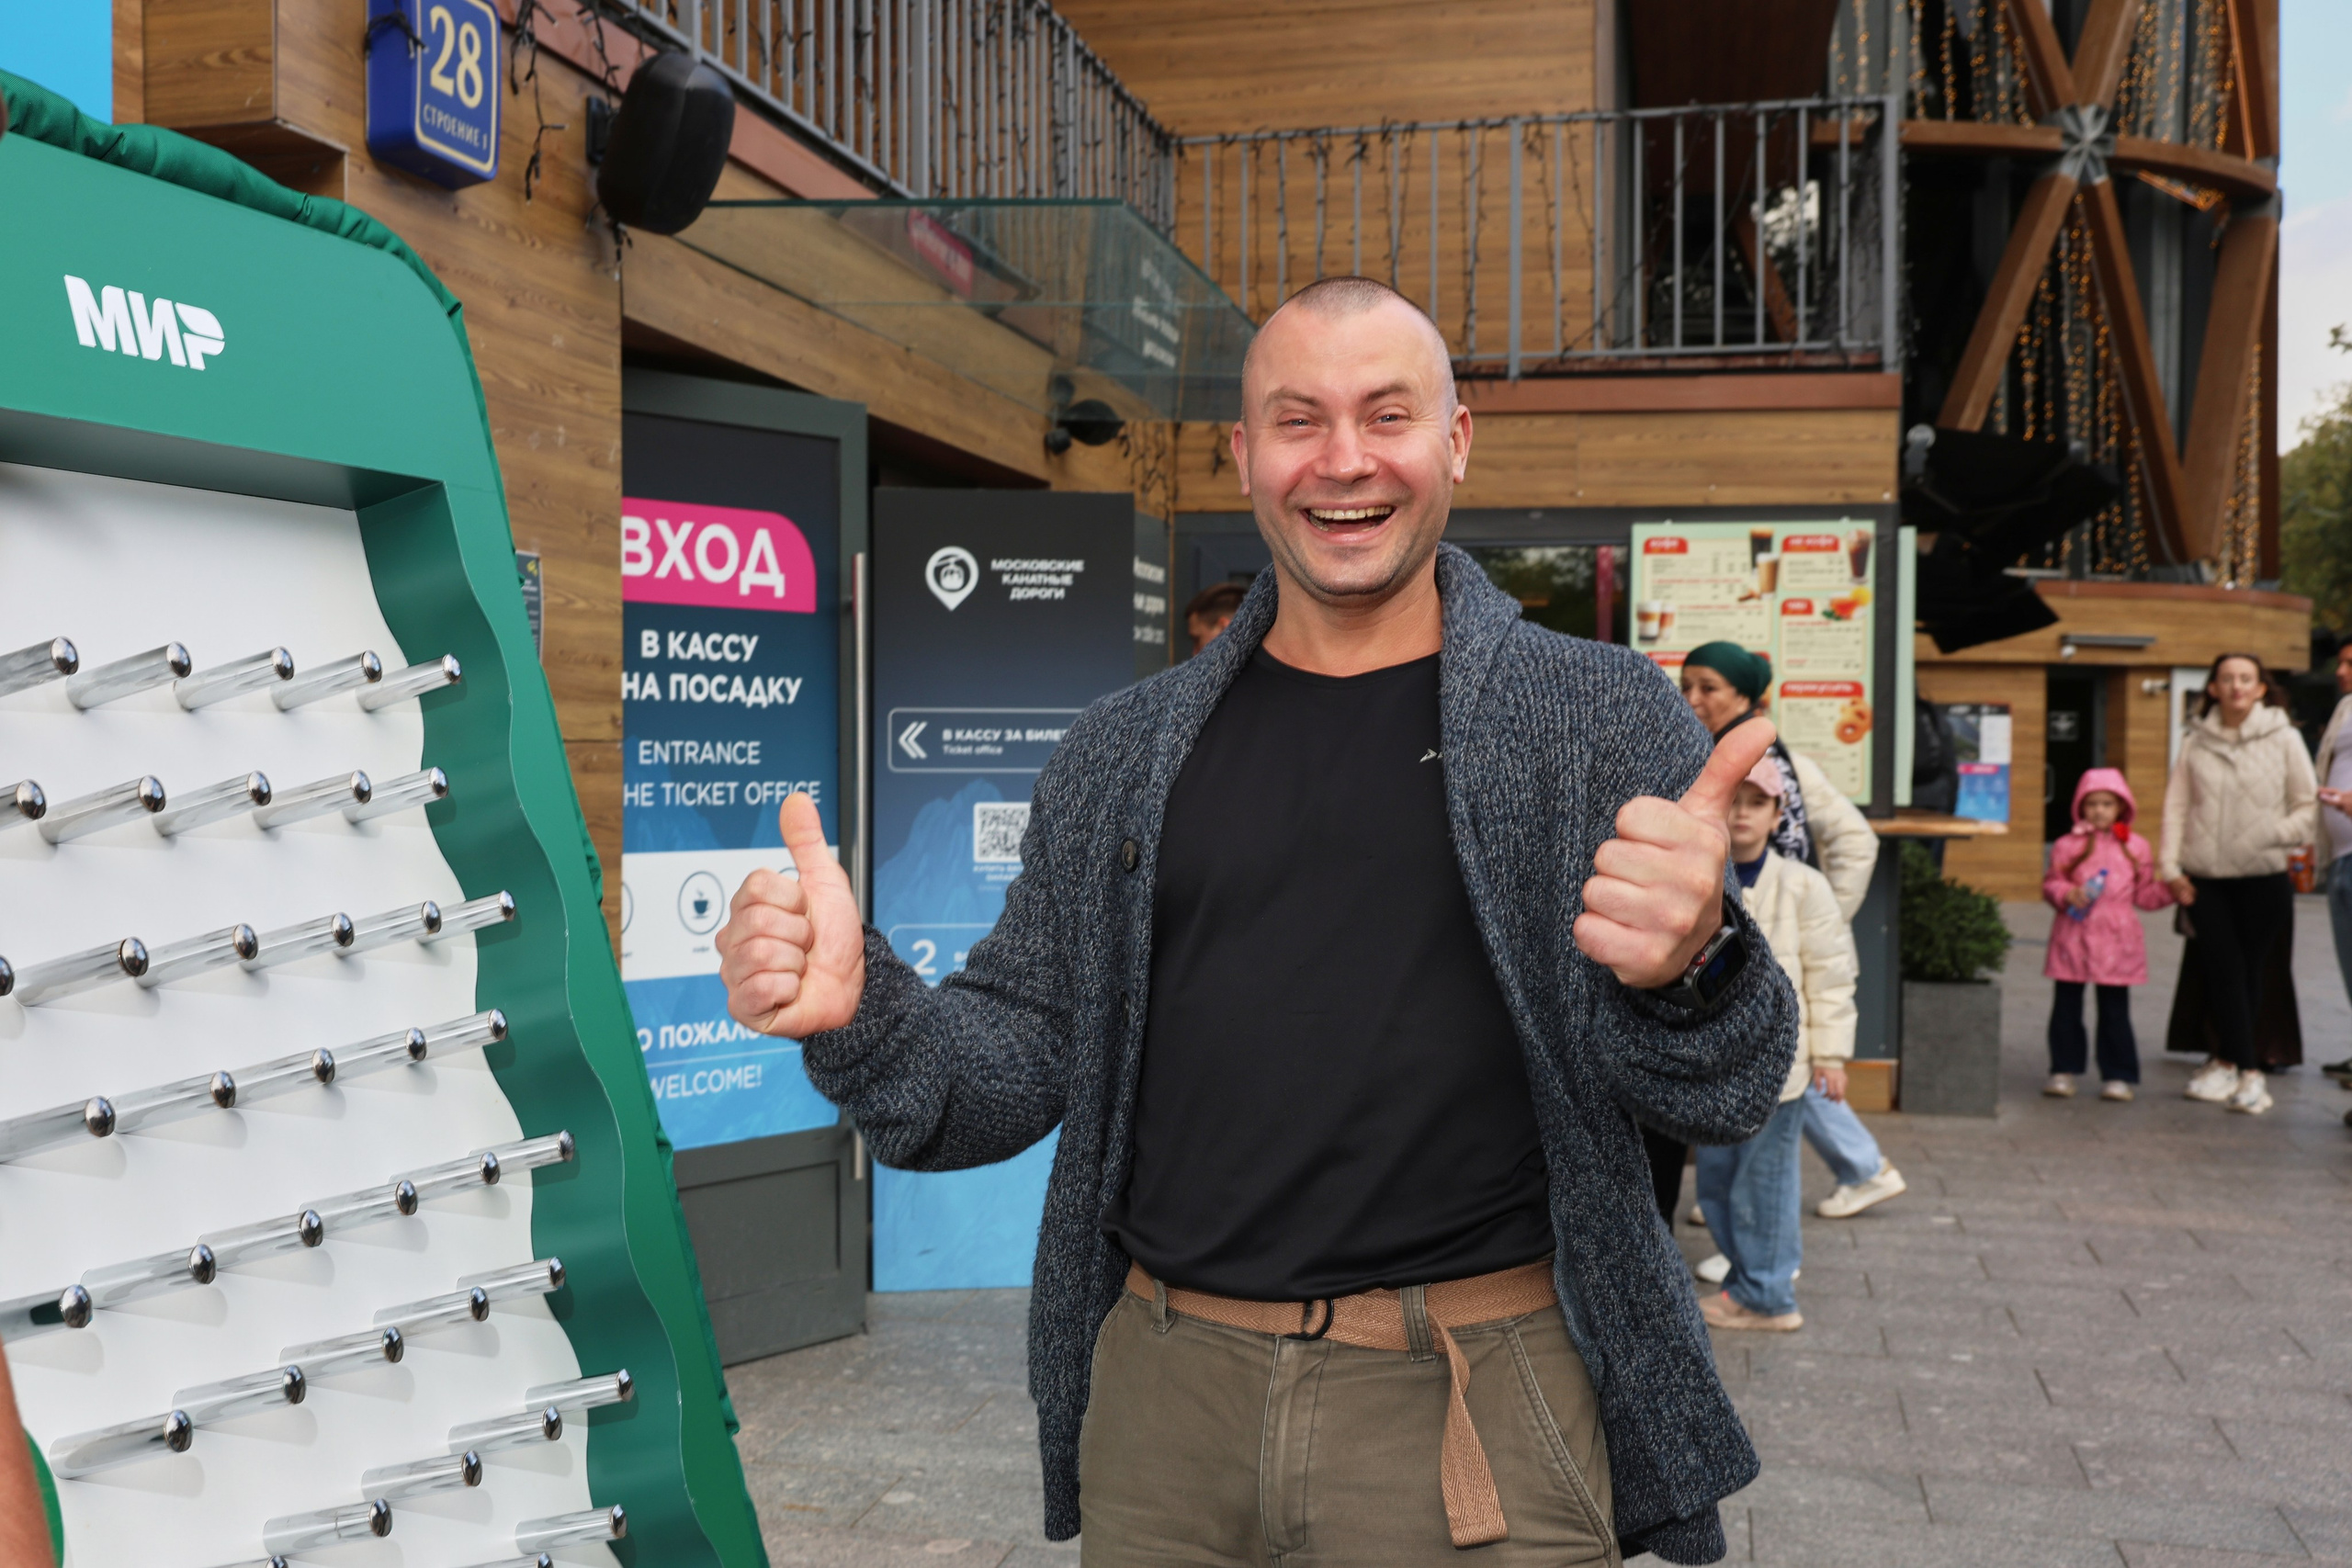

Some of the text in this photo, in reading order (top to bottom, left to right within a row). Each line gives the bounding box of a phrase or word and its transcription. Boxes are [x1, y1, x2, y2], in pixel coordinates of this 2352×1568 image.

[429, 5, 483, 108] 28
[423, 103, 481, 147] СТРОЕНИЕ
[63, 274, 225, 371] МИР
[620, 515, 786, 598] ВХОД
[990, 558, 1085, 573] МОСКОВСКИЕ
[1001, 573, 1074, 587] КАНАТНЫЕ
[1009, 587, 1066, 601] ДОРОГИ
[640, 629, 760, 662] В КАССУ
[621, 671, 803, 709] НА ПОСАДКУ
[942, 728, 953, 741] В
[955, 728, 1003, 742] КАССУ
[1004, 728, 1023, 742] ЗА
[943, 744, 1003, 755] Ticket office
[638, 739, 762, 766] ENTRANCE
[661, 781, 740, 807] TICKET
[911, 939, 937, 976] 2
[650, 1064, 763, 1100] WELCOME!
